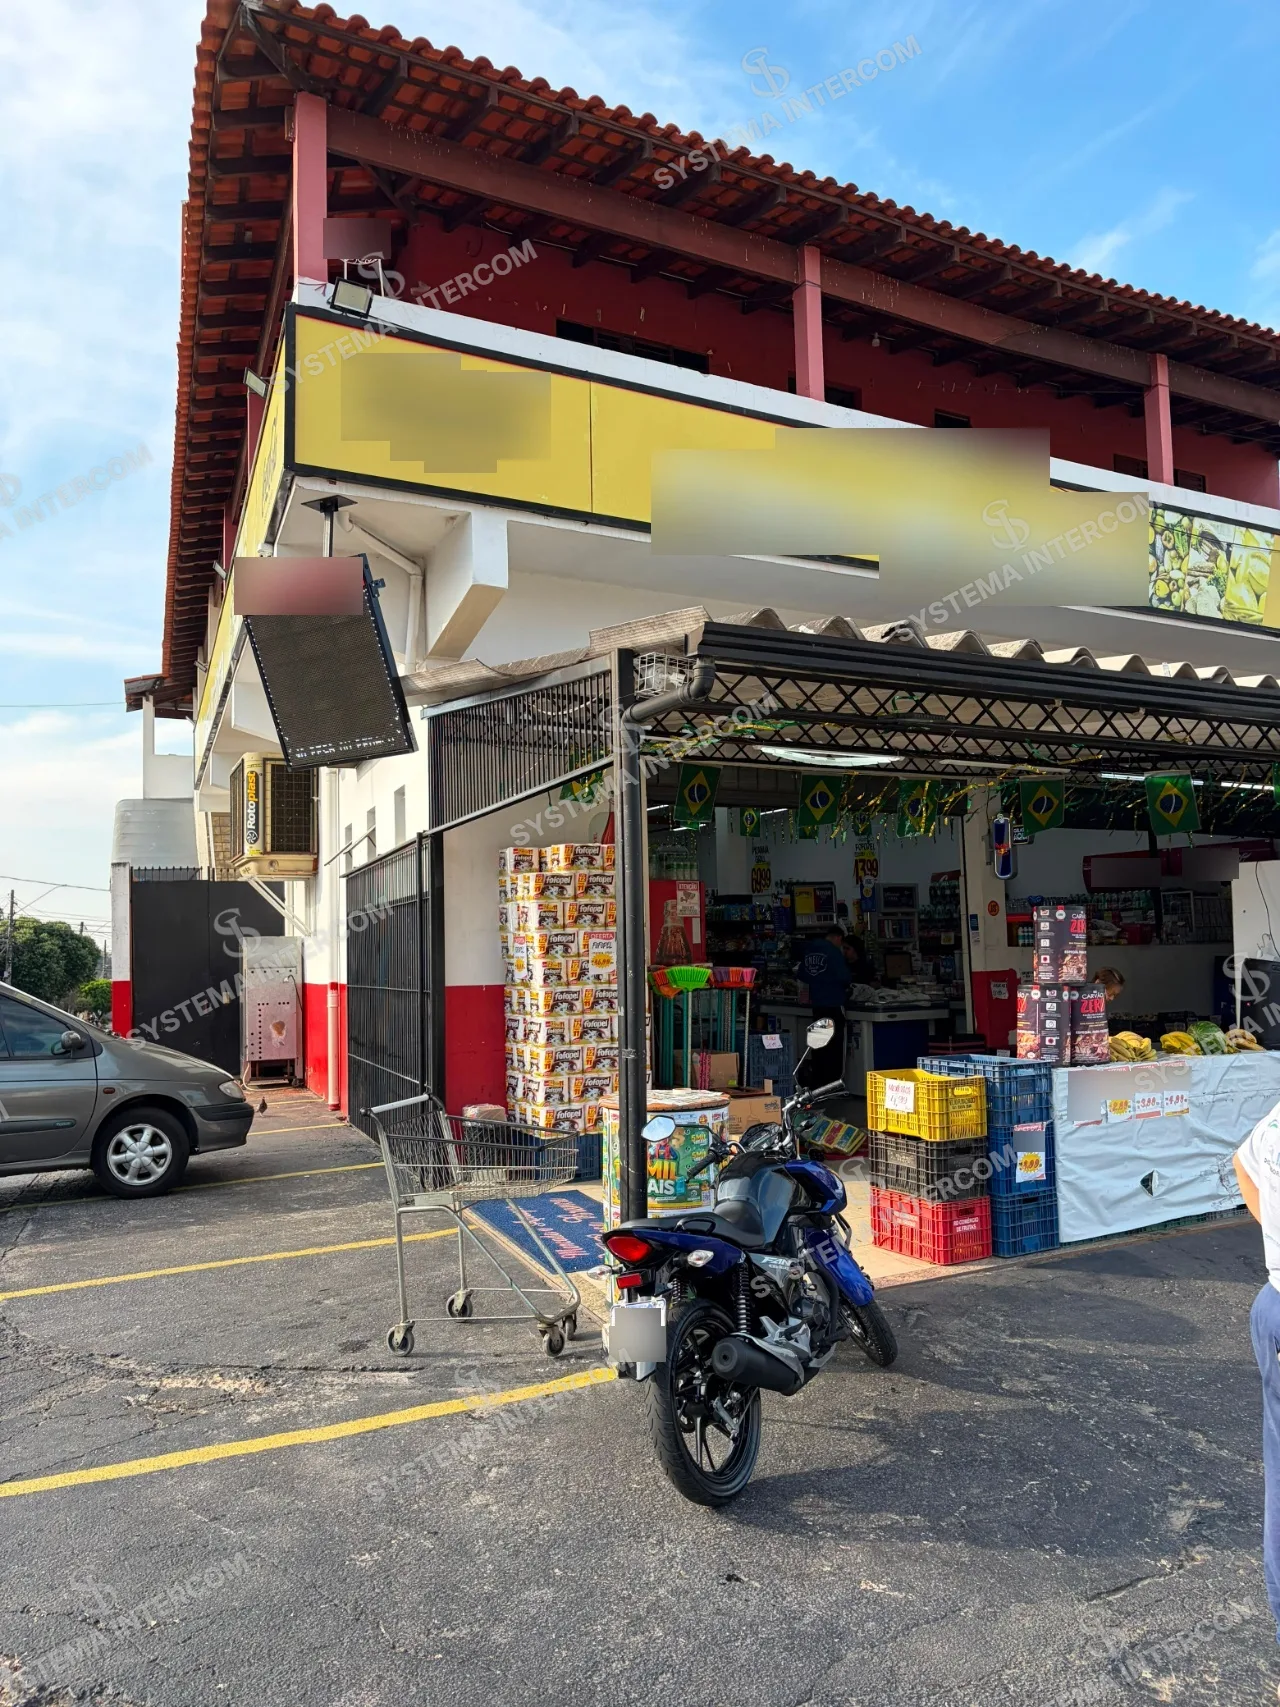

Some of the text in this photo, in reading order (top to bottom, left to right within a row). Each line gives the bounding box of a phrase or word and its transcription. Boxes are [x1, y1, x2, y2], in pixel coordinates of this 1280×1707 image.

[247, 771, 258, 829] Rotoplast
[576, 846, 599, 855] fofopel
[546, 876, 572, 884] fofopel
[589, 876, 613, 884] fofopel
[580, 904, 604, 913] fofopel
[550, 934, 574, 943] fofopel
[590, 932, 614, 940] OFERTA
[555, 992, 579, 1000] fofopel
[596, 990, 618, 999] fofope
[1082, 992, 1104, 1000] CARVÃO
[1080, 998, 1105, 1014] ZERO
[584, 1020, 608, 1028] fofopel
[556, 1052, 579, 1060] fofopel
[598, 1049, 618, 1057] fofope
[585, 1078, 610, 1086] fofopel
[556, 1111, 581, 1119] fofopel
[959, 1216, 979, 1226] COMÉRCIO
[962, 1224, 976, 1232] FRUTAS
